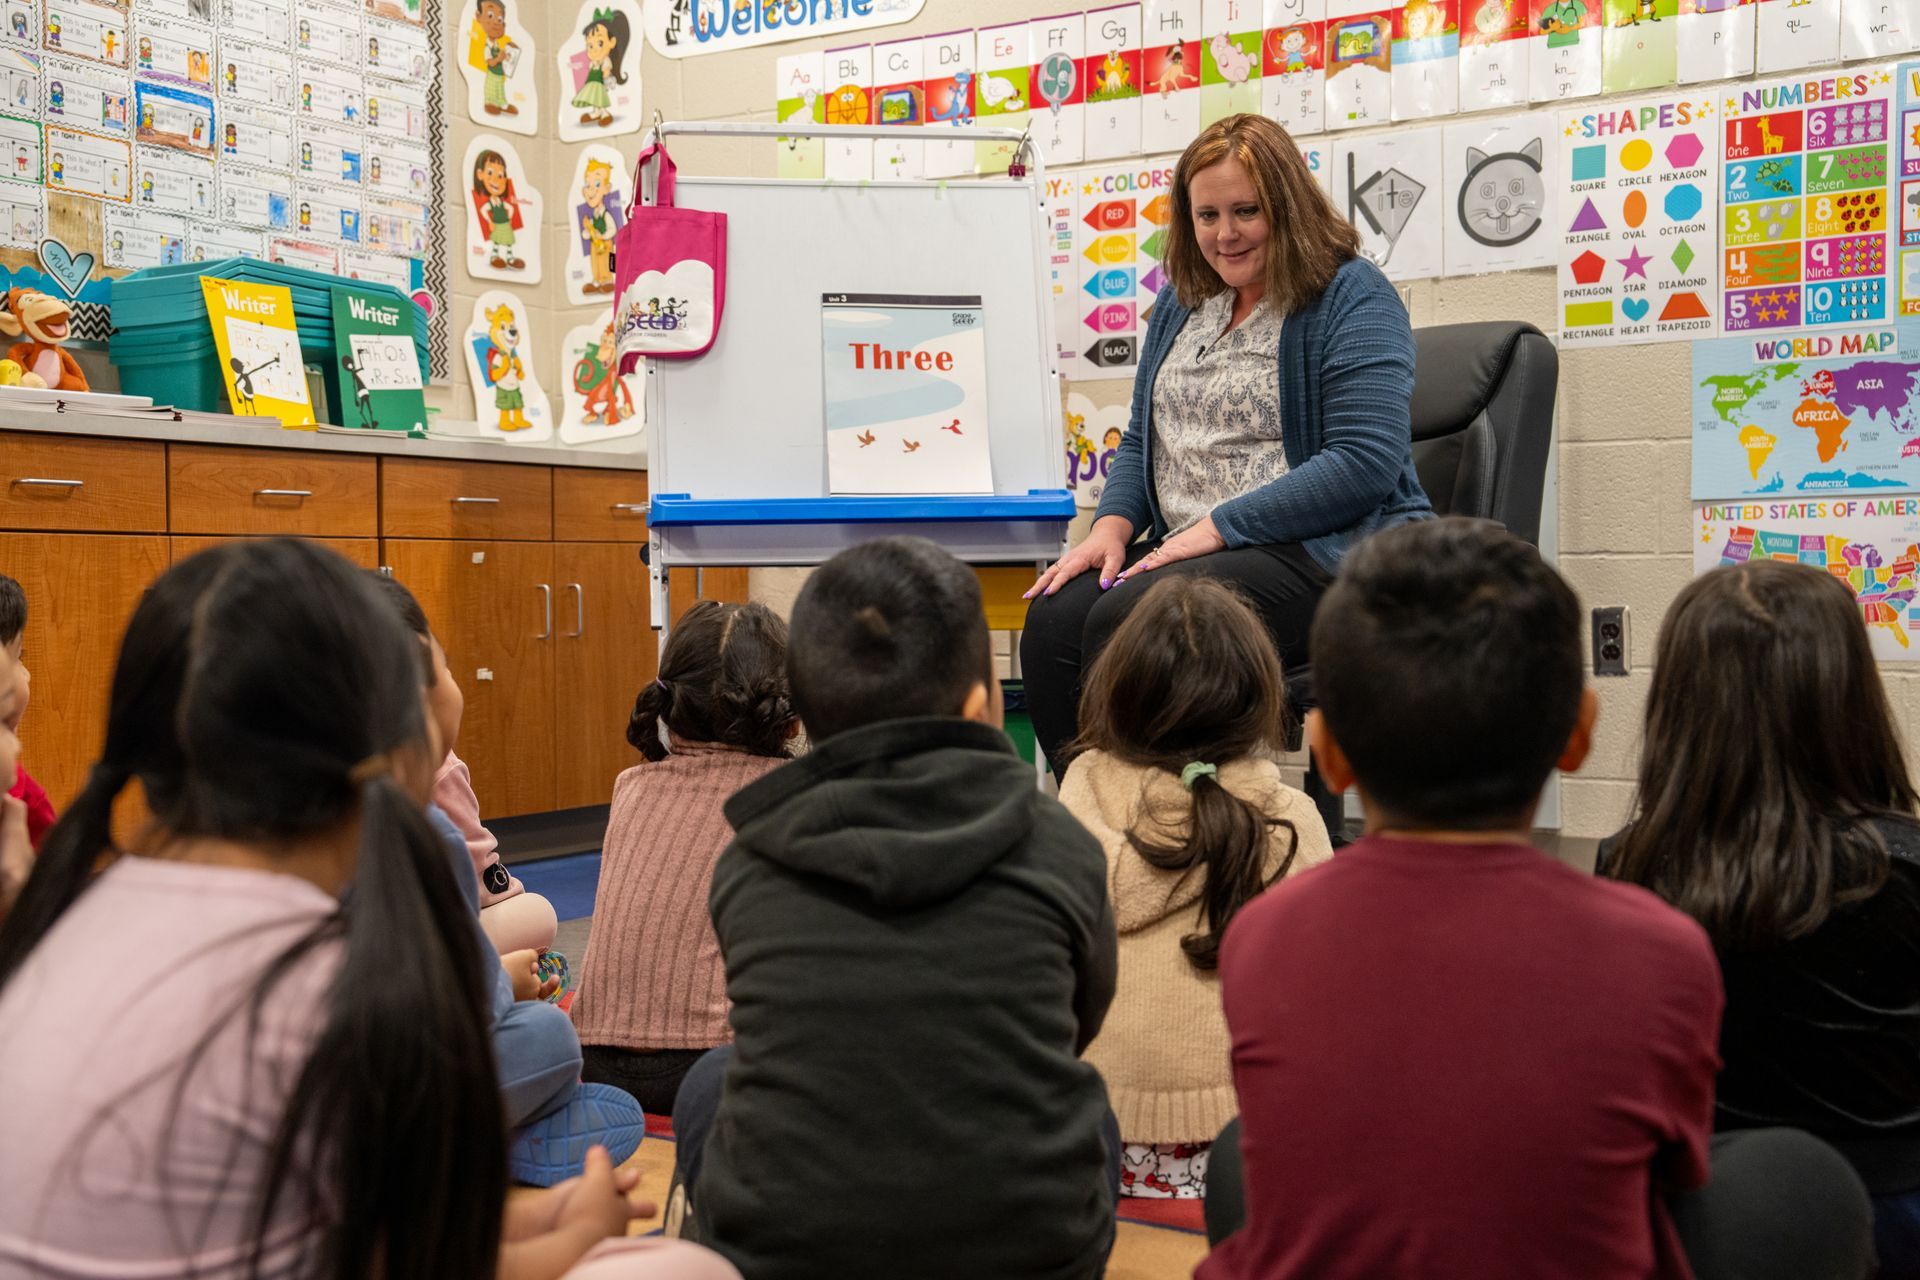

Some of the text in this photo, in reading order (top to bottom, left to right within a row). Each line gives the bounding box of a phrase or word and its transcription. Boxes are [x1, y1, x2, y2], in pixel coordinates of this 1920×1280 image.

[1228, 1, 1238, 20] Ii
[1882, 5, 1888, 13] r
[691, 0, 873, 42] Welcome
[1160, 11, 1183, 31] Hh
[1049, 28, 1067, 48] Ff
[1102, 20, 1126, 47] Gg
[1714, 32, 1721, 45] p
[940, 45, 960, 64] Dd
[994, 38, 1013, 57] Ee
[1562, 49, 1569, 57] n
[839, 59, 859, 78] Bb
[888, 53, 909, 71] Cc
[1489, 63, 1499, 71] m
[791, 68, 810, 86] Aa
[1559, 80, 1572, 95] gn
[1743, 75, 1868, 111] NUMBERS
[1581, 102, 1692, 138] SHAPES
[1809, 111, 1827, 135] 6
[1736, 121, 1742, 145] 1
[1727, 147, 1750, 158] One
[1818, 154, 1834, 179] 7
[1103, 169, 1174, 193] COLORS
[1618, 176, 1652, 187] CIRCLE
[1660, 169, 1707, 182] HEXAGON
[1730, 165, 1746, 190] 2
[1571, 181, 1606, 192] SQUARE
[1808, 180, 1845, 193] Seven
[1727, 191, 1750, 201] Two
[1106, 208, 1124, 220] RED
[1815, 198, 1833, 221] 8
[1735, 209, 1751, 232] 3
[1622, 230, 1646, 239] OVAL
[1660, 224, 1706, 236] OCTAGON
[1565, 232, 1610, 244] TRIANGLE
[1726, 232, 1760, 244] Three
[1730, 250, 1748, 274] 4
[1811, 243, 1829, 267] 9
[50, 250, 76, 282] nice
[1104, 278, 1126, 290] BLUE
[1624, 283, 1646, 292] STAR
[1659, 277, 1707, 289] DIAMOND
[1726, 275, 1752, 286] Four
[1564, 286, 1612, 298] PENTAGON
[221, 287, 276, 315] Writer
[1731, 295, 1746, 318] 5
[1807, 287, 1833, 312] 10
[348, 296, 399, 326] Writer
[1104, 312, 1128, 324] PINK
[1809, 311, 1831, 322] Ten
[1620, 325, 1650, 335] HEART
[1656, 320, 1711, 332] TRAPEZOID
[1563, 328, 1615, 339] RECTANGLE
[1104, 345, 1129, 357] BLACK
[1756, 332, 1895, 360] WORLD MAP
[848, 343, 954, 371] Three
[1857, 379, 1884, 390] ASIA
[1716, 394, 1748, 402] AMERICA
[1795, 411, 1839, 422] AFRICA
[1804, 480, 1849, 488] ANTARCTICA
[1702, 505, 1764, 521] UNITED
[1769, 503, 1827, 519] STATES
[1833, 502, 1857, 517] OF
